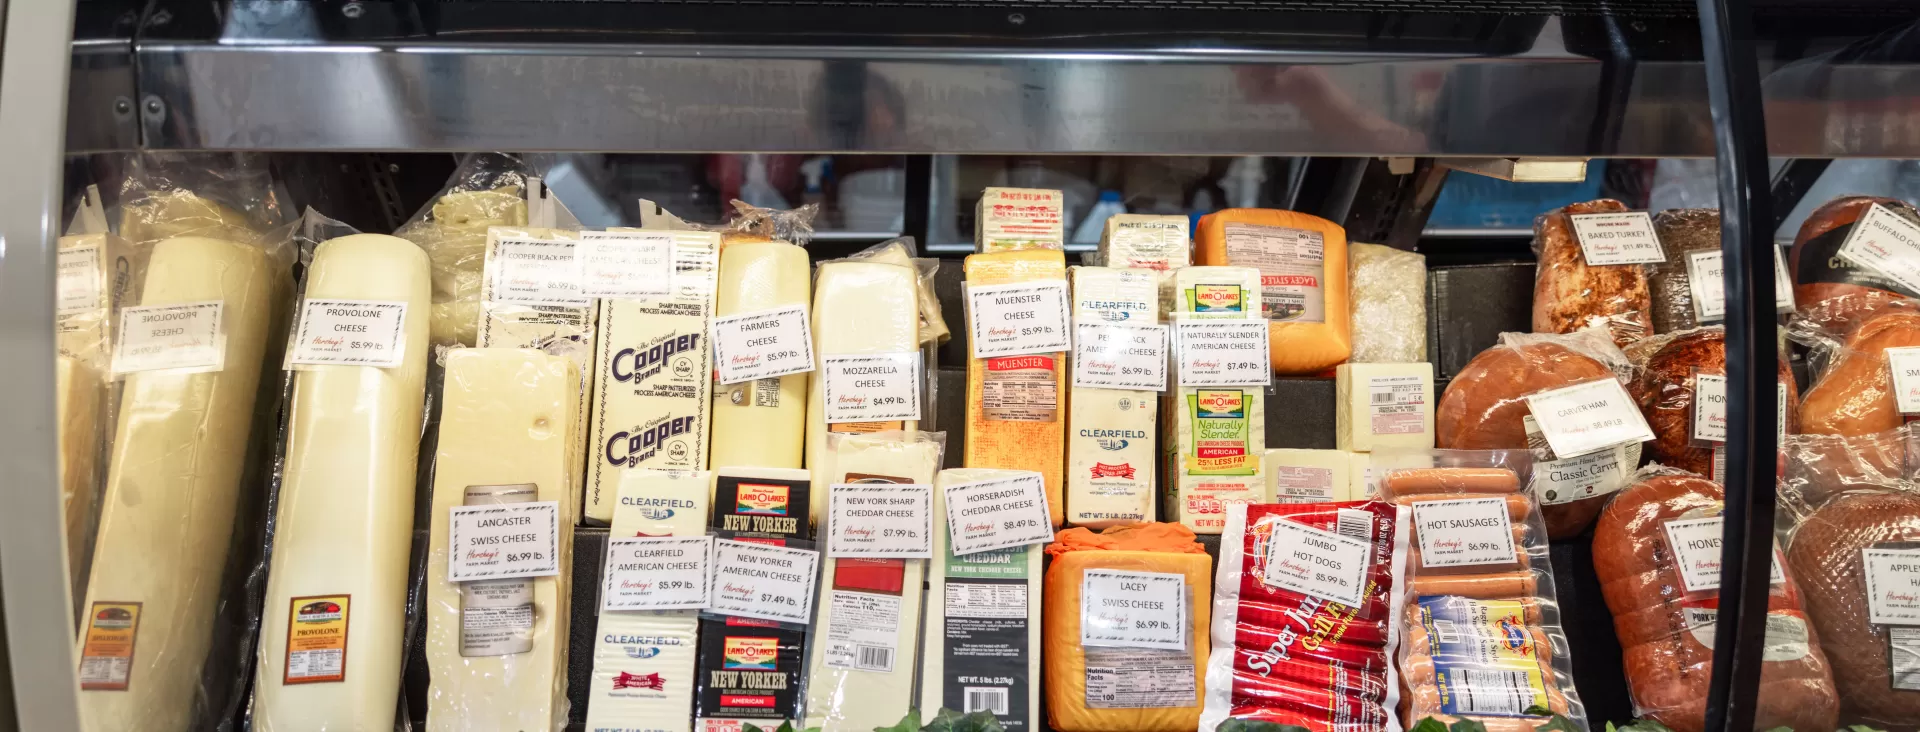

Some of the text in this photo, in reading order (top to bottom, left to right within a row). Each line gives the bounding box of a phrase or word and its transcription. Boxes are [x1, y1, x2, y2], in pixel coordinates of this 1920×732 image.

[1588, 230, 1646, 240] BAKED TURKEY
[1873, 220, 1906, 242] BUFFALO
[508, 252, 559, 262] COOPER BLACK
[548, 281, 569, 290] $6.99
[1268, 276, 1314, 286] LACEY STYLE
[995, 294, 1042, 306] MUENSTER
[1198, 292, 1213, 300] LAND
[1081, 300, 1147, 310] CLEARFIELD
[326, 308, 382, 318] PROVOLONE
[660, 308, 684, 316] AMERICAN
[1004, 310, 1036, 321] CHEESE
[334, 324, 368, 333] CHEESE
[740, 320, 780, 332] FARMERS
[988, 324, 1017, 338] Hershey's
[1022, 326, 1043, 336] $5.99
[312, 336, 344, 348] Hershey's
[650, 329, 676, 346] Original
[746, 336, 778, 348] CHEESE
[350, 342, 373, 350] $5.99
[1190, 342, 1256, 350] AMERICAN CHEESE
[767, 351, 788, 362] $5.99
[1128, 348, 1157, 356] CHEESE
[612, 333, 700, 384] Cooper
[731, 352, 760, 365] Hershey's
[997, 357, 1044, 370] MUENSTER
[1192, 358, 1220, 371] Hershey's
[1228, 362, 1248, 370] $7.49
[634, 364, 662, 385] Brand
[842, 366, 898, 375] MOZZARELLA
[1122, 366, 1143, 375] $6.99
[653, 384, 668, 392] SHARP
[854, 380, 886, 388] CHEESE
[654, 390, 678, 398] AMERICAN
[838, 394, 868, 406] Hershey's
[874, 396, 895, 406] $4.99
[1200, 398, 1241, 406] LAND LAKES
[1557, 399, 1608, 418] CARVER HAM
[645, 412, 671, 430] Original
[1198, 420, 1244, 432] Naturally
[1080, 429, 1146, 439] CLEARFIELD
[606, 416, 695, 466] Cooper
[628, 448, 656, 468] Brand
[1198, 456, 1247, 466] 25% LESS FAT
[1550, 460, 1578, 470] Premium
[1550, 462, 1618, 482] Classic Carver
[740, 493, 786, 502] LAND LAKES
[966, 488, 1025, 503] HORSERADISH
[621, 496, 694, 508] CLEARFIELD
[889, 498, 916, 506] SHARP
[885, 510, 914, 518] CHEESE
[961, 500, 1034, 517] CHEDDAR CHEESE
[1121, 512, 1144, 520] (2.27kg)
[477, 516, 531, 528] LANCASTER
[723, 514, 798, 534] NEW YORKER
[964, 520, 996, 534] Hershey's
[1004, 518, 1039, 530] $8.49 lb.
[1427, 518, 1500, 530] HOT SAUSAGES
[844, 525, 876, 538] Hershey's
[883, 528, 918, 538] $7.99 lb.
[470, 533, 537, 546] SWISS CHEESE
[1302, 536, 1338, 552] JUMBO
[1434, 538, 1463, 550] Hershey's
[1468, 542, 1502, 551] $6.99 lb.
[467, 548, 500, 562] Hershey's
[506, 552, 532, 562] $6.99
[634, 549, 684, 558] CLEARFIELD
[963, 554, 1011, 564] CHEDDAR
[736, 554, 793, 568] NEW YORKER
[1293, 551, 1342, 570] HOT DOGS
[618, 562, 698, 572] AMERICAN CHEESE
[978, 566, 1001, 574] CHEDDAR
[722, 566, 802, 583] AMERICAN CHEESE
[1316, 572, 1338, 585] $5.99
[620, 580, 653, 592] Hershey's
[658, 580, 682, 590] $5.99
[723, 582, 755, 598] Hershey's
[1120, 582, 1148, 592] LACEY
[761, 593, 785, 604] $7.49
[1886, 590, 1918, 604] Hershey's
[1102, 598, 1165, 610] SWISS CHEESE
[1692, 612, 1710, 622] PORK
[1135, 620, 1172, 630] $6.99 lb.
[297, 628, 340, 636] PROVOLONE
[1302, 615, 1335, 651] Grill
[1330, 624, 1348, 645] Smoke
[604, 634, 680, 646] CLEARFIELD
[756, 648, 775, 656] LAKES
[1248, 624, 1298, 678] Super
[710, 670, 788, 690] NEW YORKER
[958, 676, 969, 684] NET
[970, 676, 979, 684] WT.
